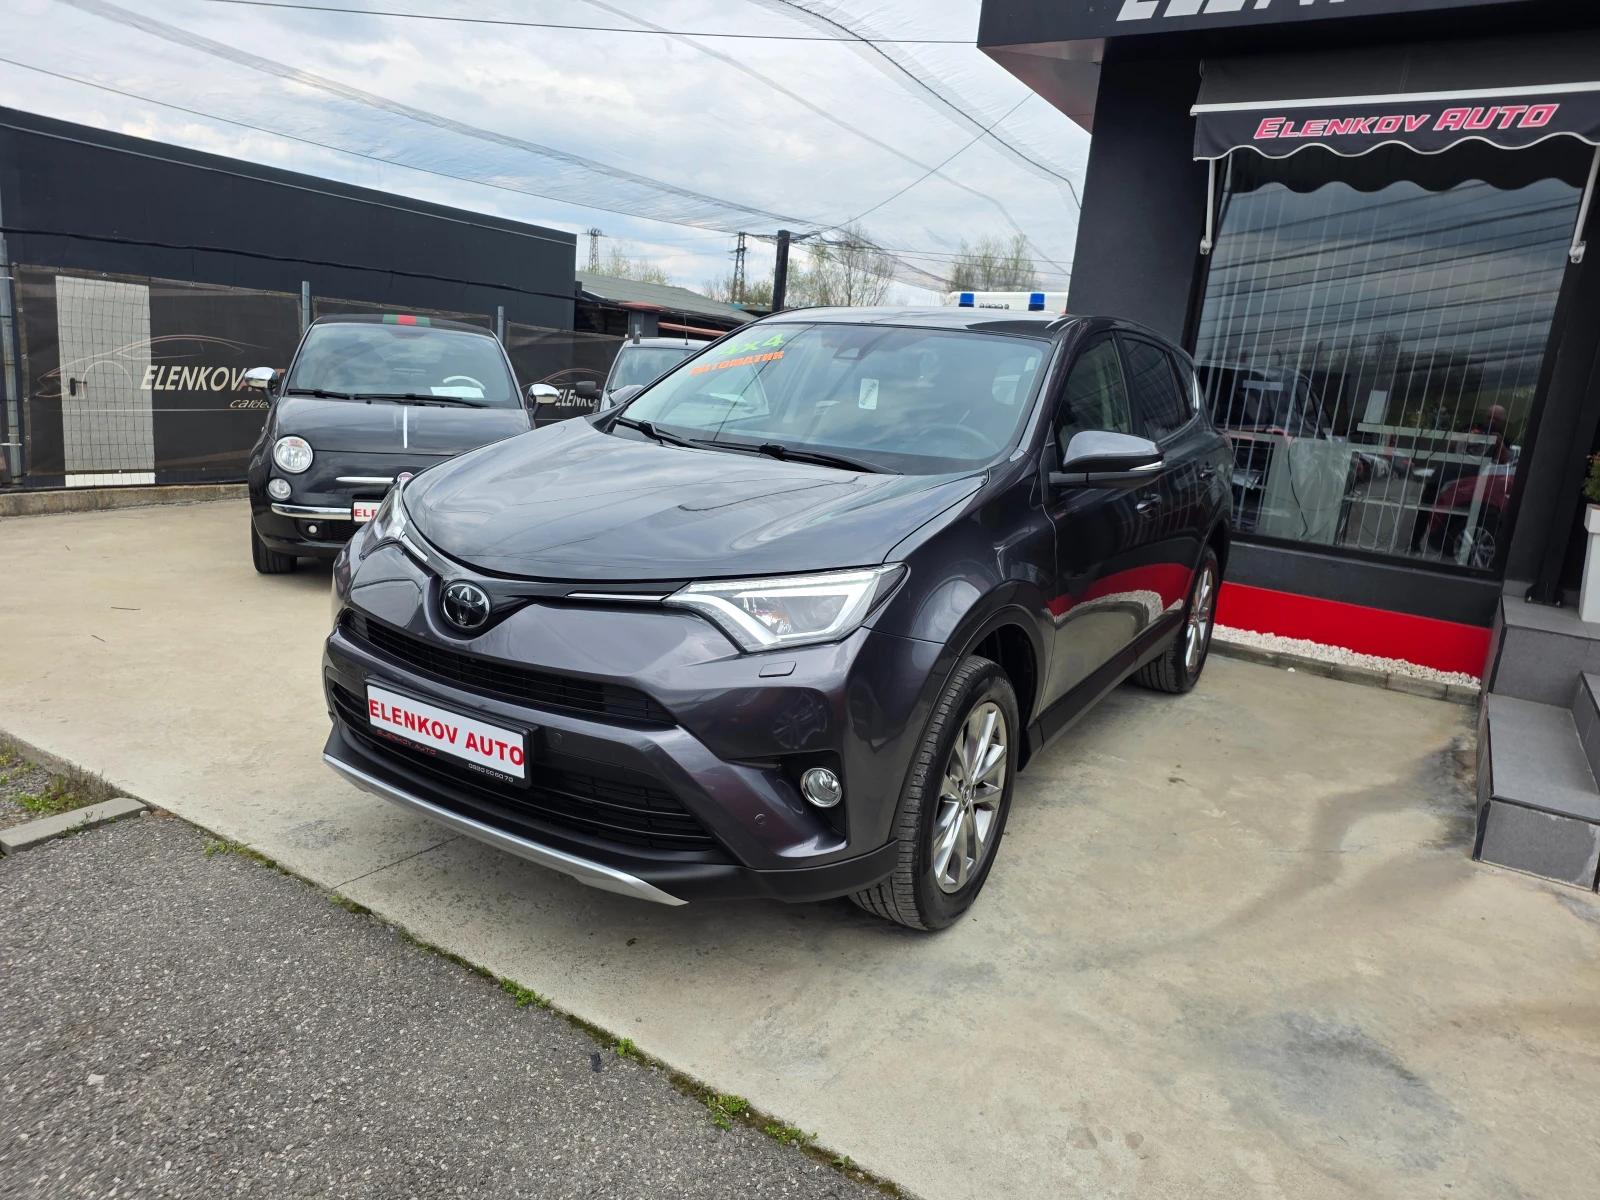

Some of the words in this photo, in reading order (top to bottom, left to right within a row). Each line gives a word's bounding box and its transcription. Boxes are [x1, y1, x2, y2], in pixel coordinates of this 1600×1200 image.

[1253, 114, 1431, 139] ELENKOV
[1433, 103, 1560, 131] AUTO
[140, 365, 247, 391] ELENKOV
[368, 698, 459, 745] ELENKOV
[464, 731, 525, 766] AUTO
